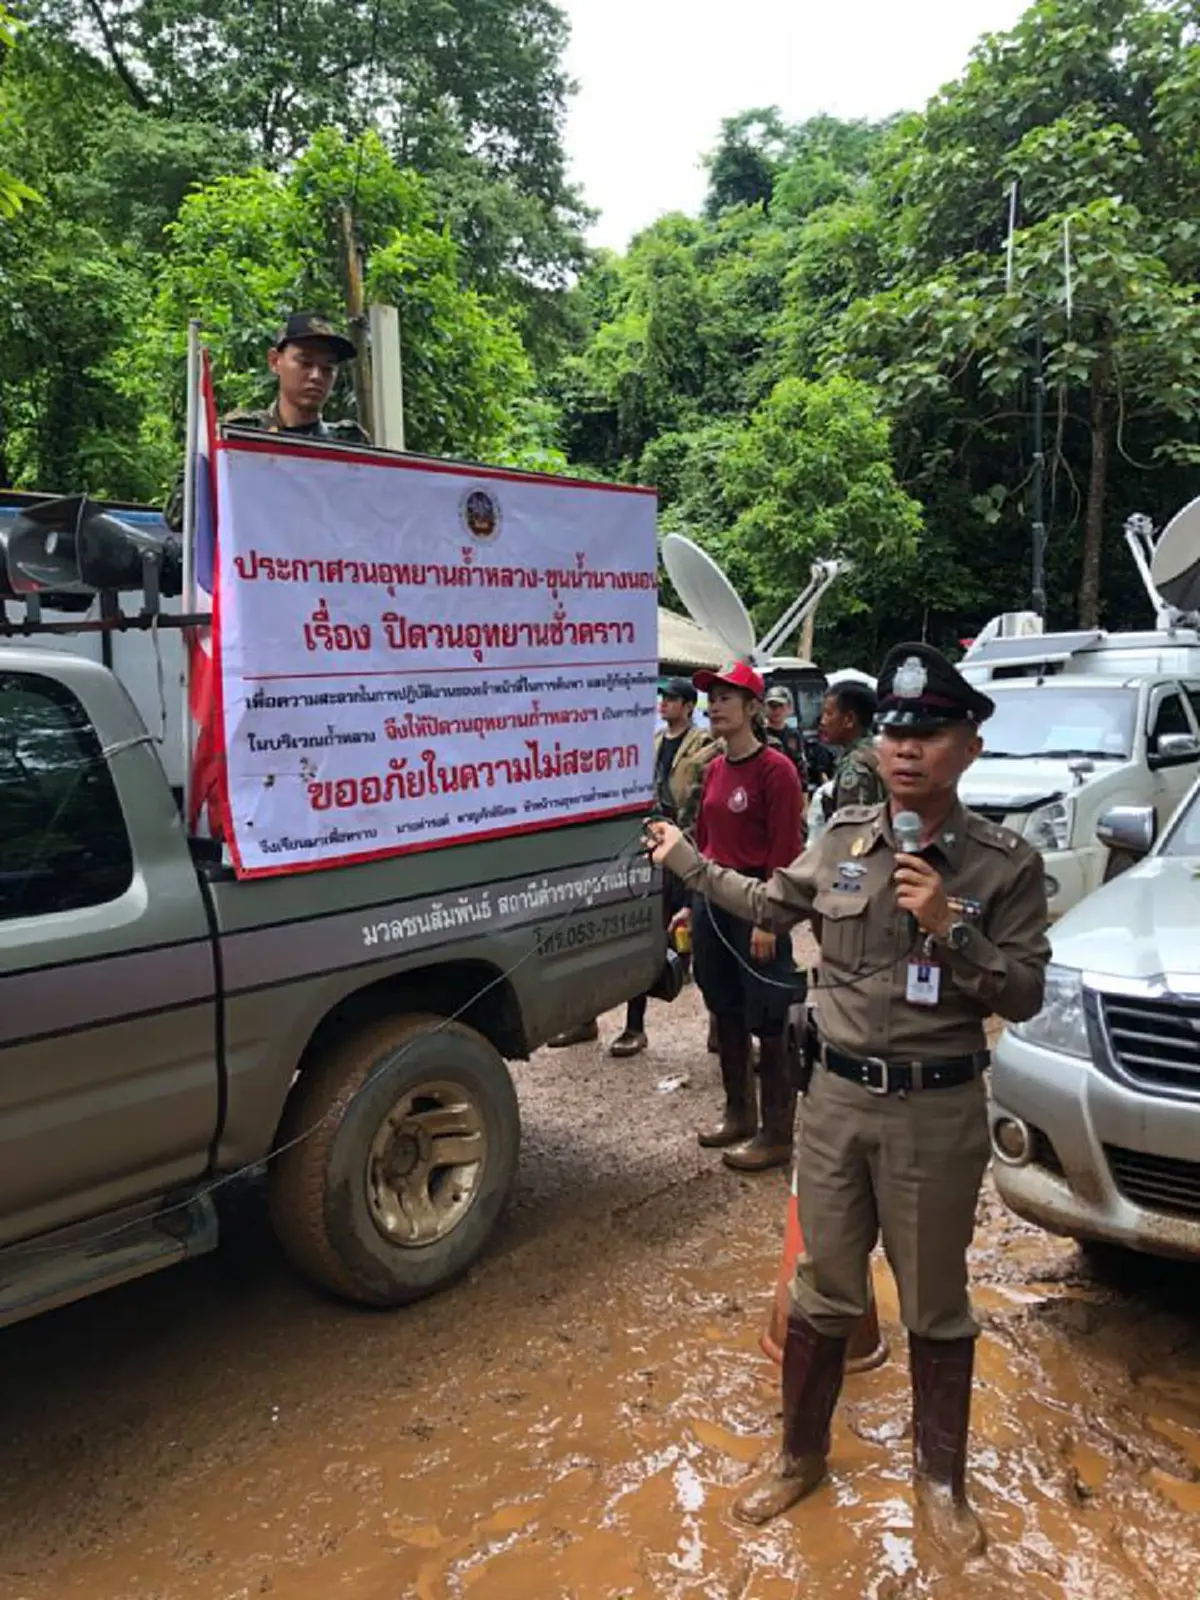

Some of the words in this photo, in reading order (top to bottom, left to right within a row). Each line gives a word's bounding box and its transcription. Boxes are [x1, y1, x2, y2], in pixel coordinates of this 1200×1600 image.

[304, 598, 371, 650] เรื่อง
[382, 602, 635, 662] ปิดวนอุทยานชั่วคราว
[248, 724, 376, 752] ในบริเวณถ้ำหลวง
[384, 700, 598, 740] จึงให้ปิดวนอุทยานถ้ำหลวงฯ
[307, 740, 639, 811] ขออภัยในความไม่สะดวก
[362, 891, 493, 946] มวลชนสัมพันธ์
